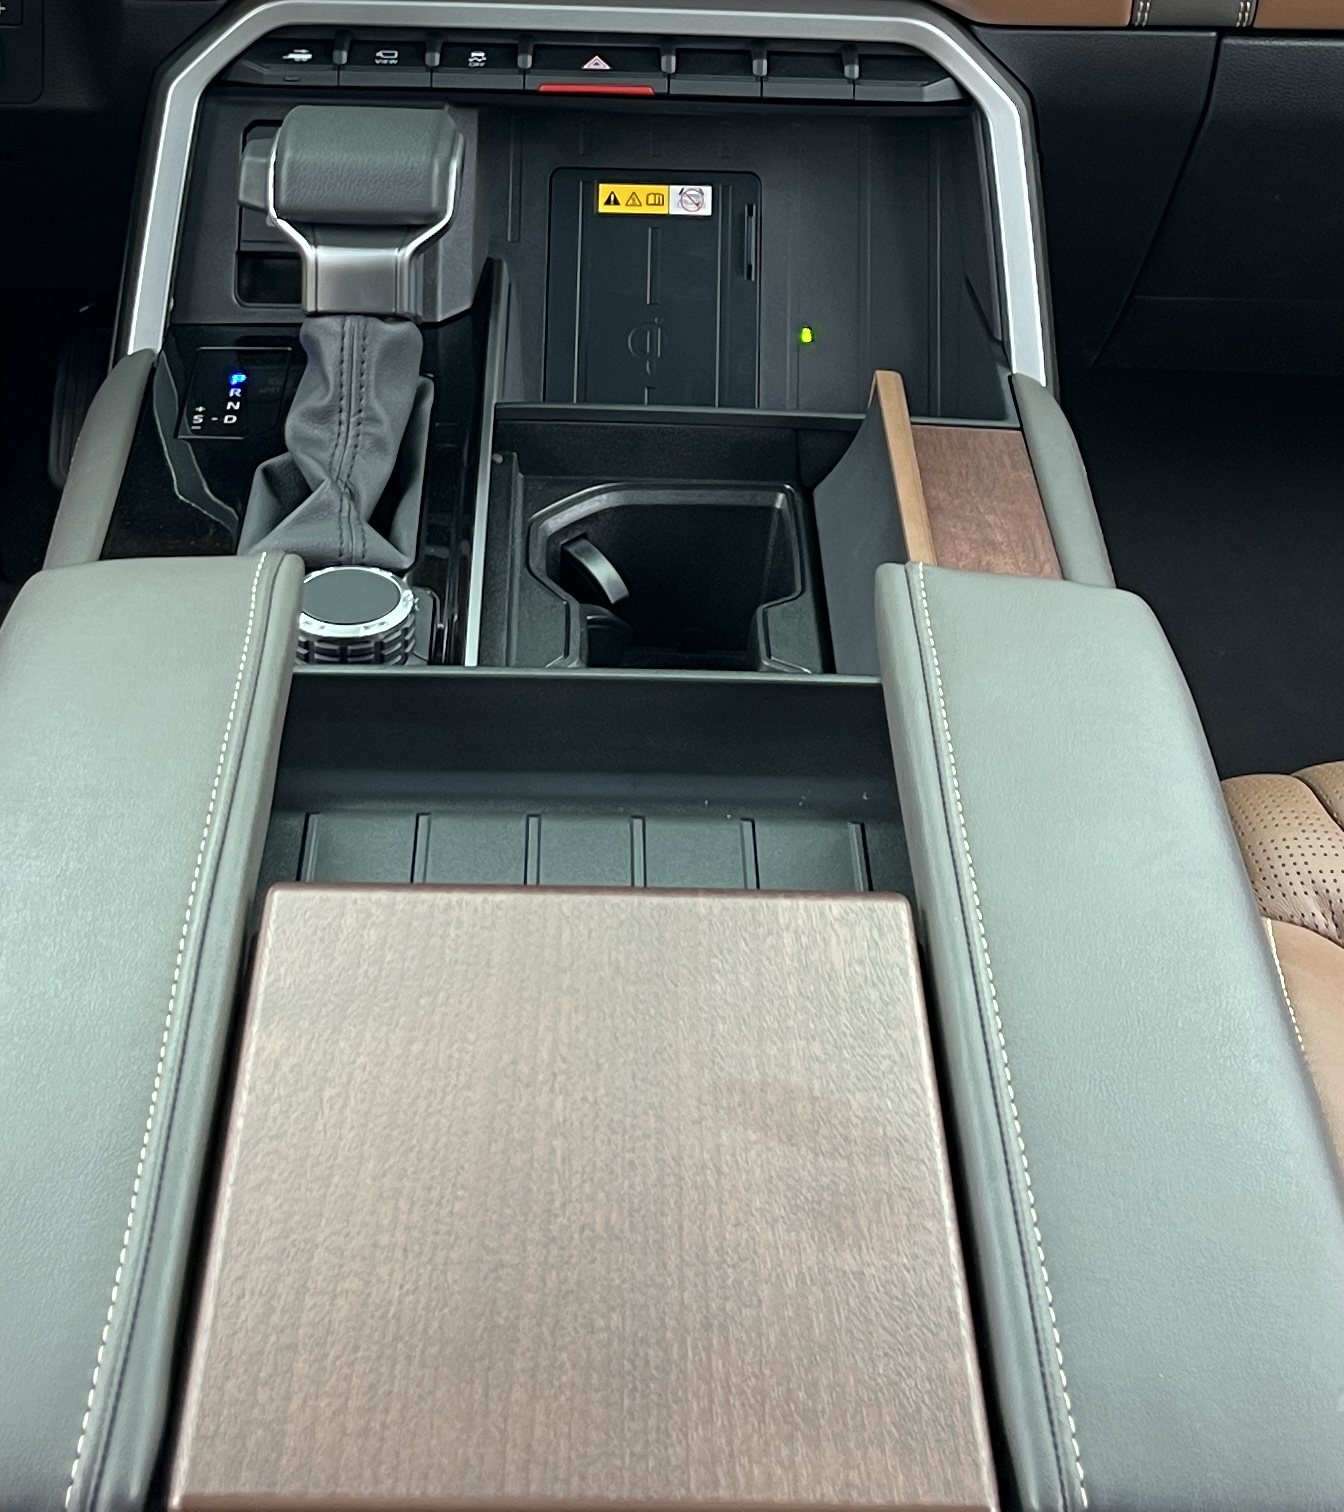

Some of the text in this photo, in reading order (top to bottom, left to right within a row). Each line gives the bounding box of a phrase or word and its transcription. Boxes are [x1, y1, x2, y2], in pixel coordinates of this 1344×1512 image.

[229, 373, 247, 386] P
[228, 387, 242, 397] R
[226, 401, 241, 410] N
[223, 414, 238, 424] D
